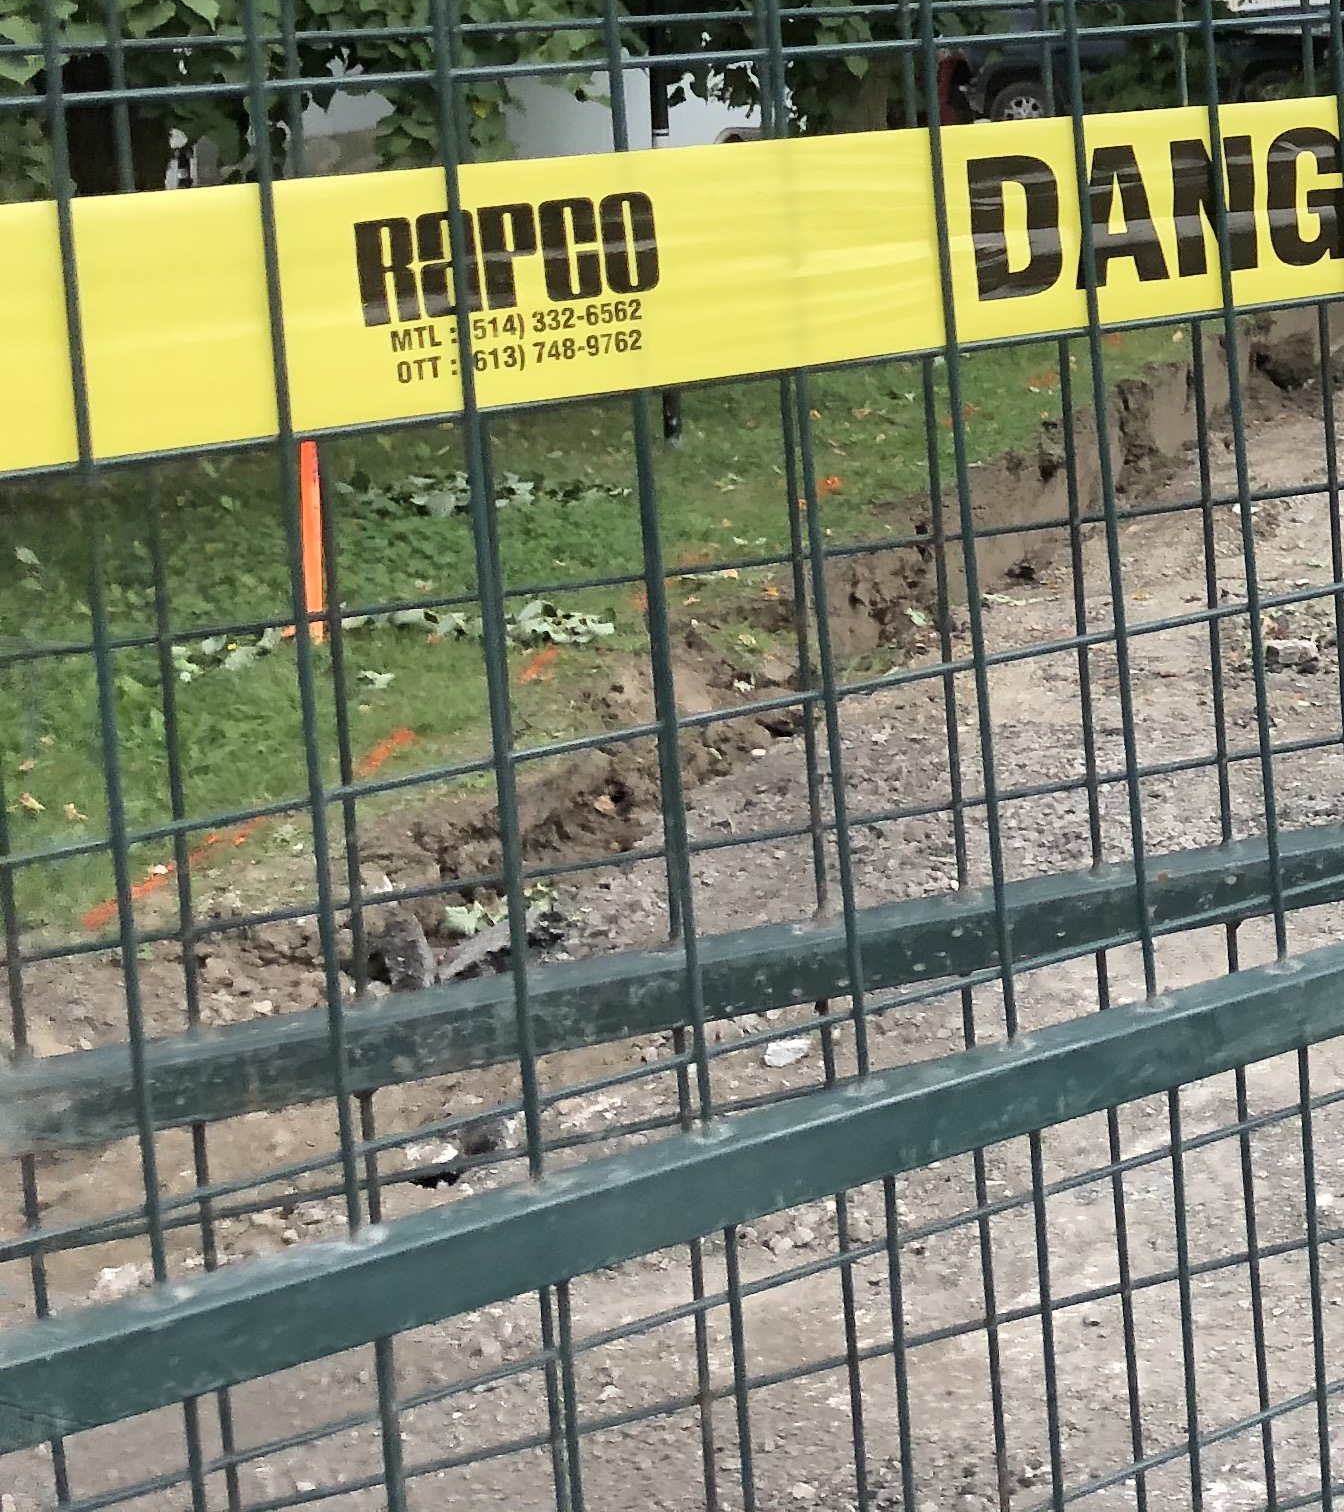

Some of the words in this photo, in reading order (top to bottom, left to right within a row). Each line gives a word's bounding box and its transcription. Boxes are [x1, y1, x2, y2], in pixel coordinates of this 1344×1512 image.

[390, 325, 442, 353] MTL
[472, 313, 526, 340] 514)
[531, 299, 643, 333] 332-6562
[396, 356, 442, 384] OTT
[473, 344, 526, 371] 613)
[532, 329, 643, 364] 748-9762
